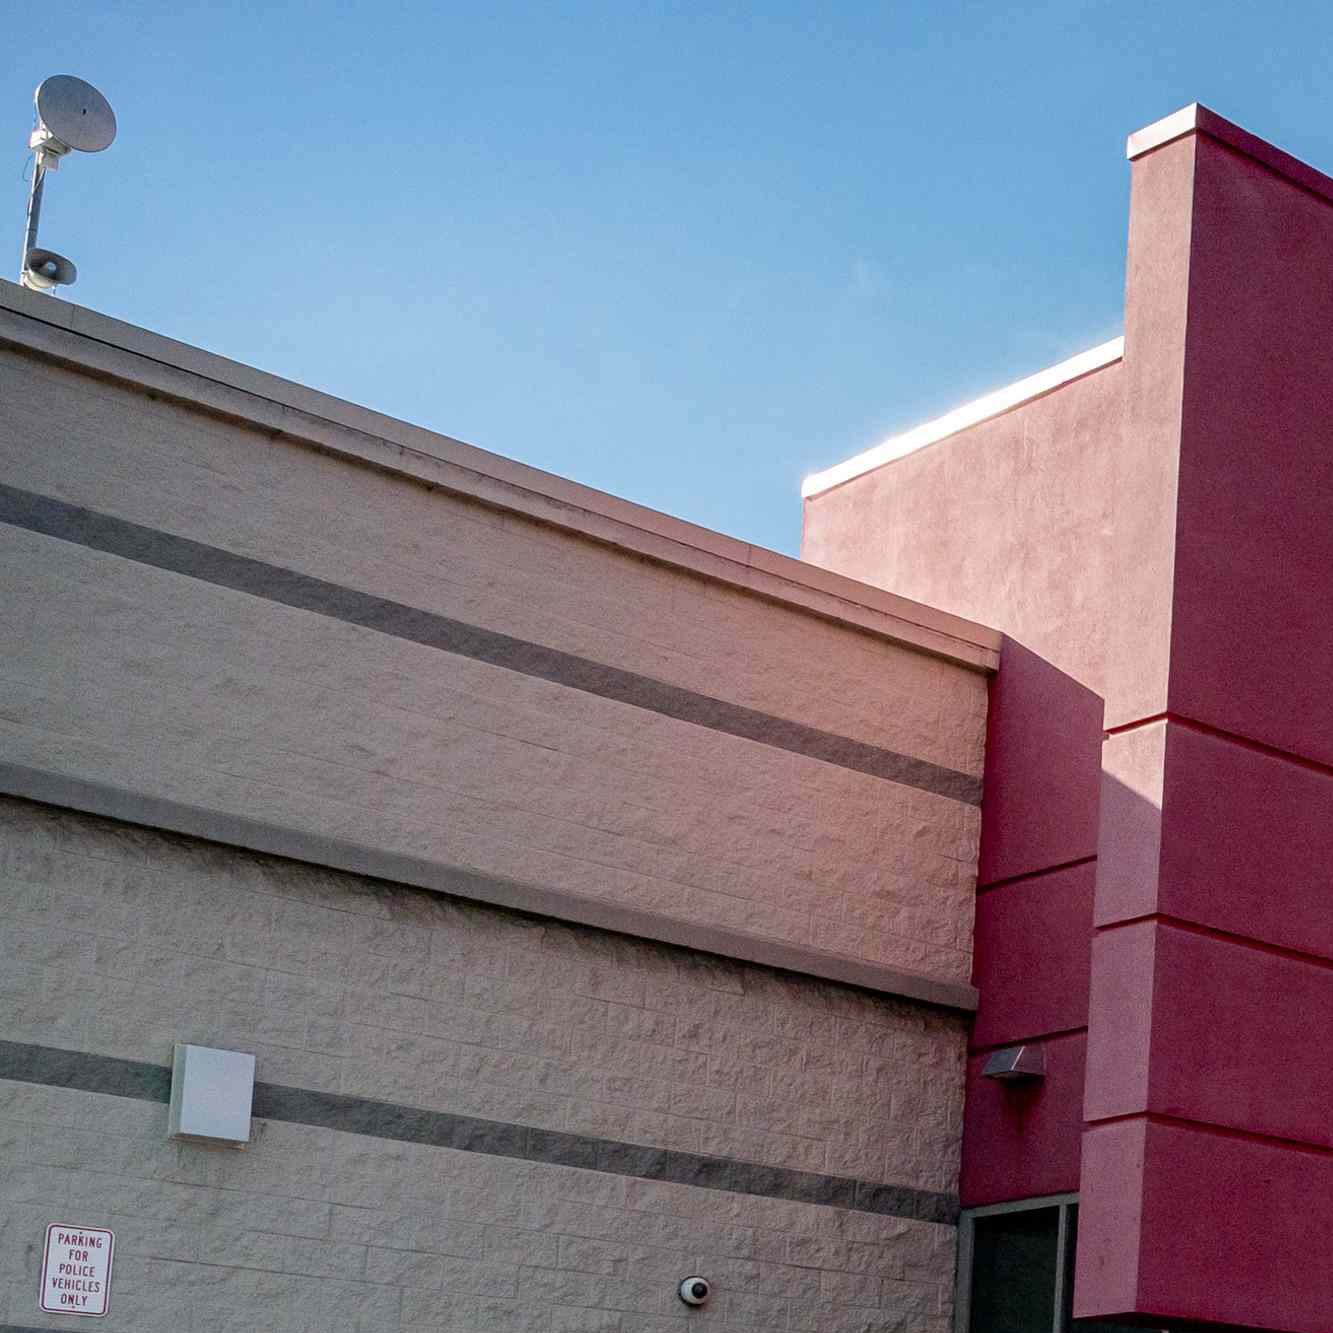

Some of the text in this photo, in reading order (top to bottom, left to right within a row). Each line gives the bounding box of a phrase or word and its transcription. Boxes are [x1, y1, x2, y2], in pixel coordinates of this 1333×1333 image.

[58, 1232, 102, 1249] PARKING
[69, 1249, 89, 1262] FOR
[59, 1263, 96, 1278] POLICE
[52, 1278, 101, 1293] VEHICLES
[60, 1293, 88, 1307] ONLY
